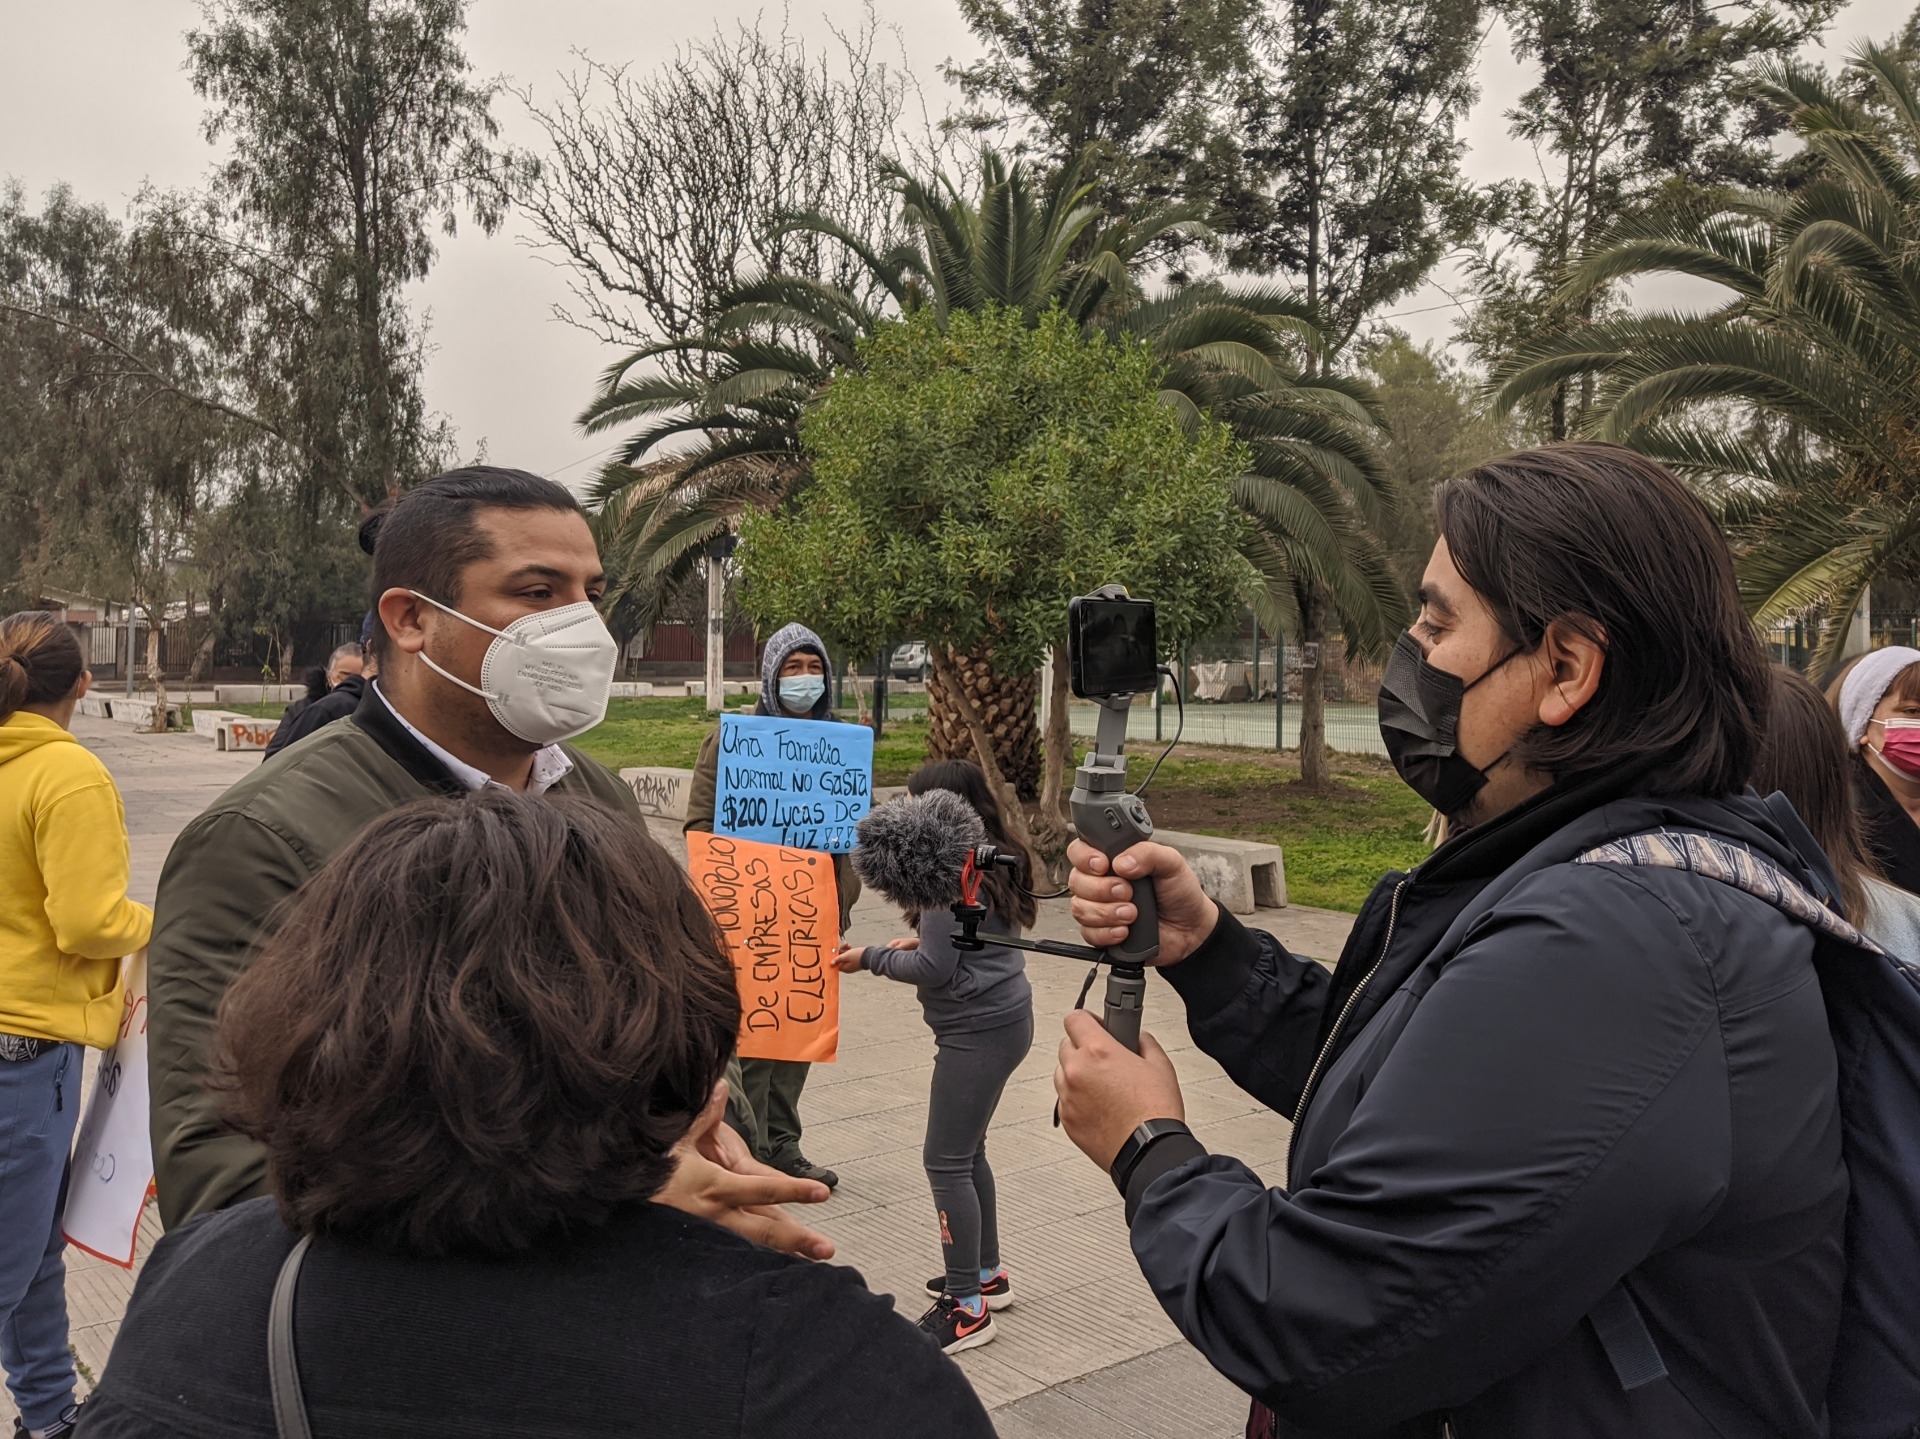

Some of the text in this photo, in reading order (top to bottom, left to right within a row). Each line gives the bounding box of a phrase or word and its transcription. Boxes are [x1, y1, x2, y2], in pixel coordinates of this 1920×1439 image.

[722, 721, 847, 767] Una Familia
[792, 770, 813, 793] NO
[721, 794, 768, 832] $200
